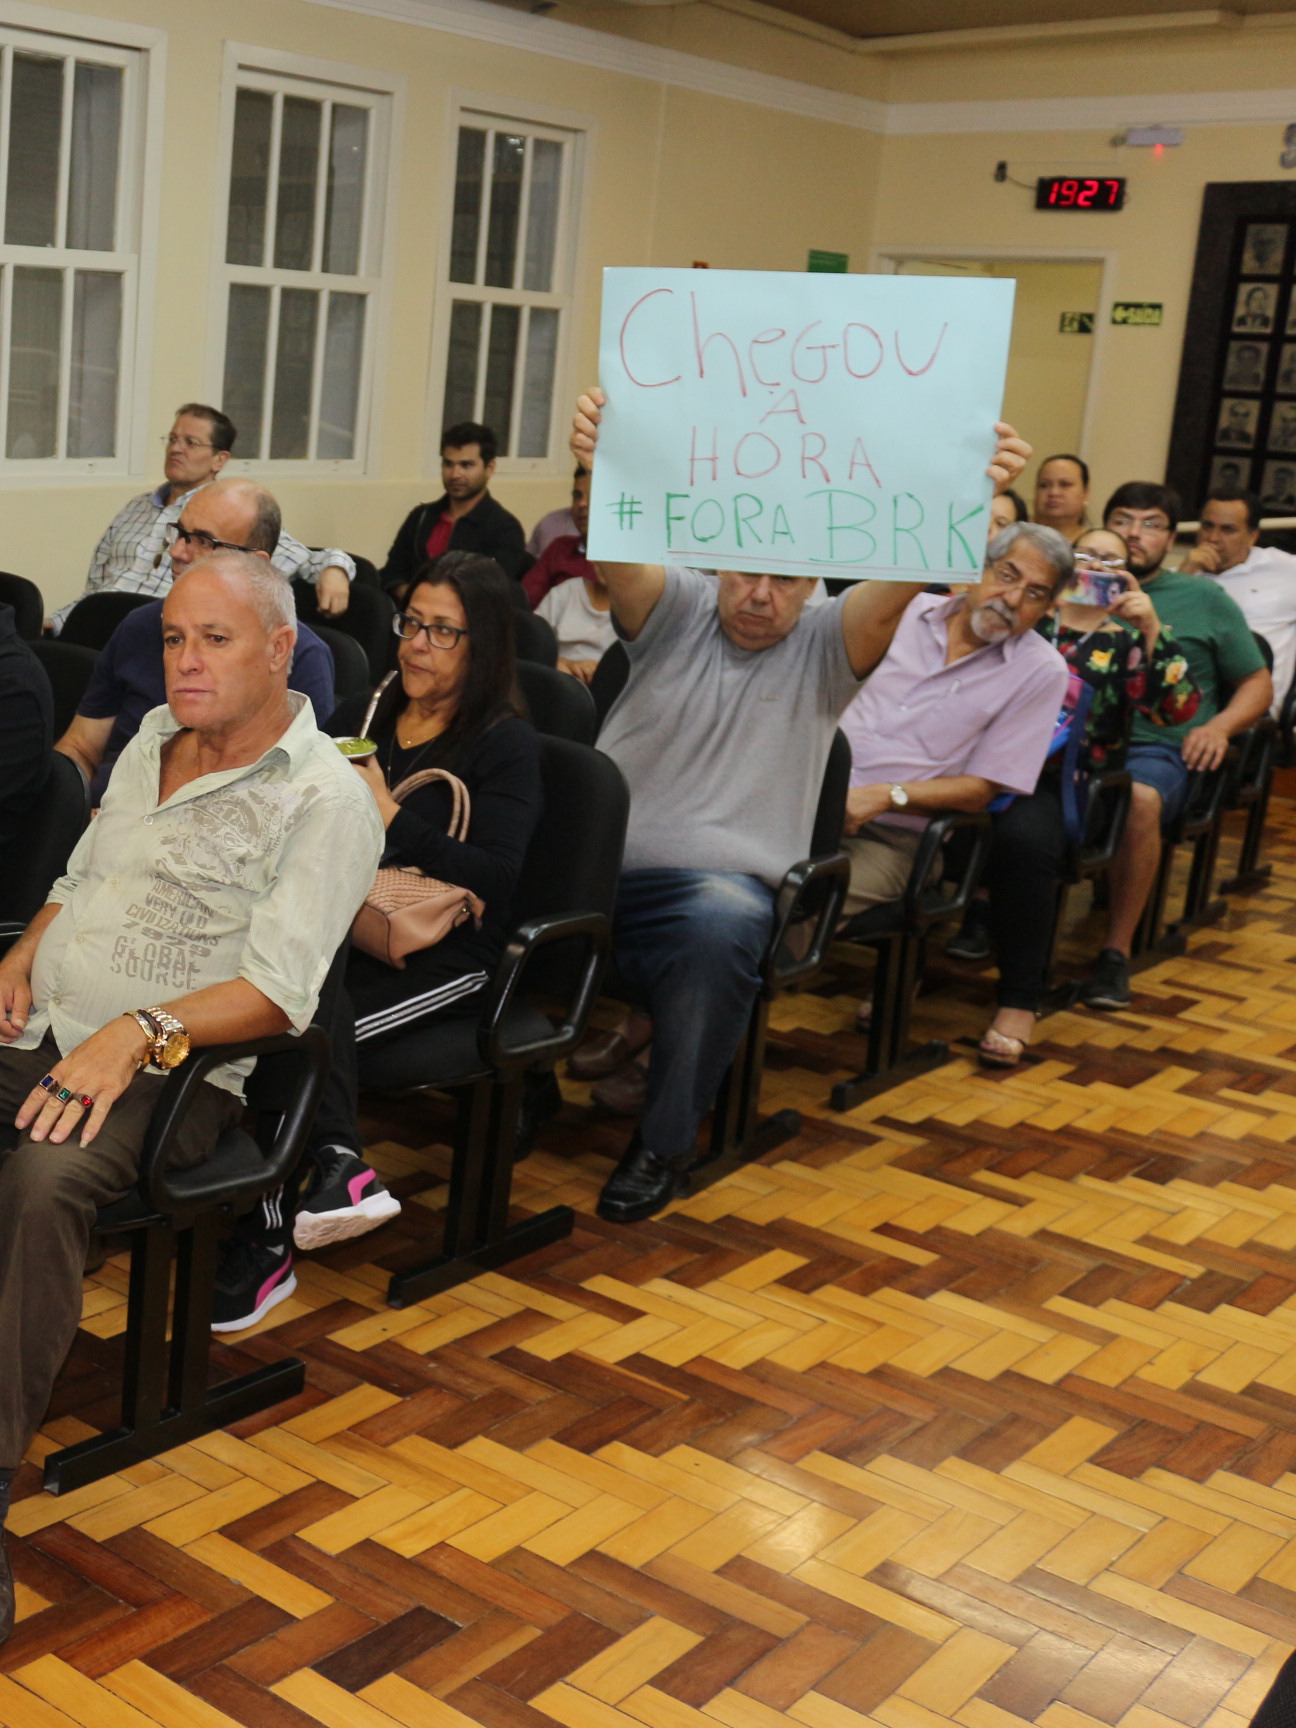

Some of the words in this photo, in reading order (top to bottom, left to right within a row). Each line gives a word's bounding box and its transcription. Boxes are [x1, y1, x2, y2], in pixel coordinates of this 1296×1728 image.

[689, 425, 882, 488] HORA
[665, 492, 795, 549] FORA
[805, 488, 985, 570] BRK
[145, 892, 177, 919] VERY
[152, 880, 214, 918] AMERICAN
